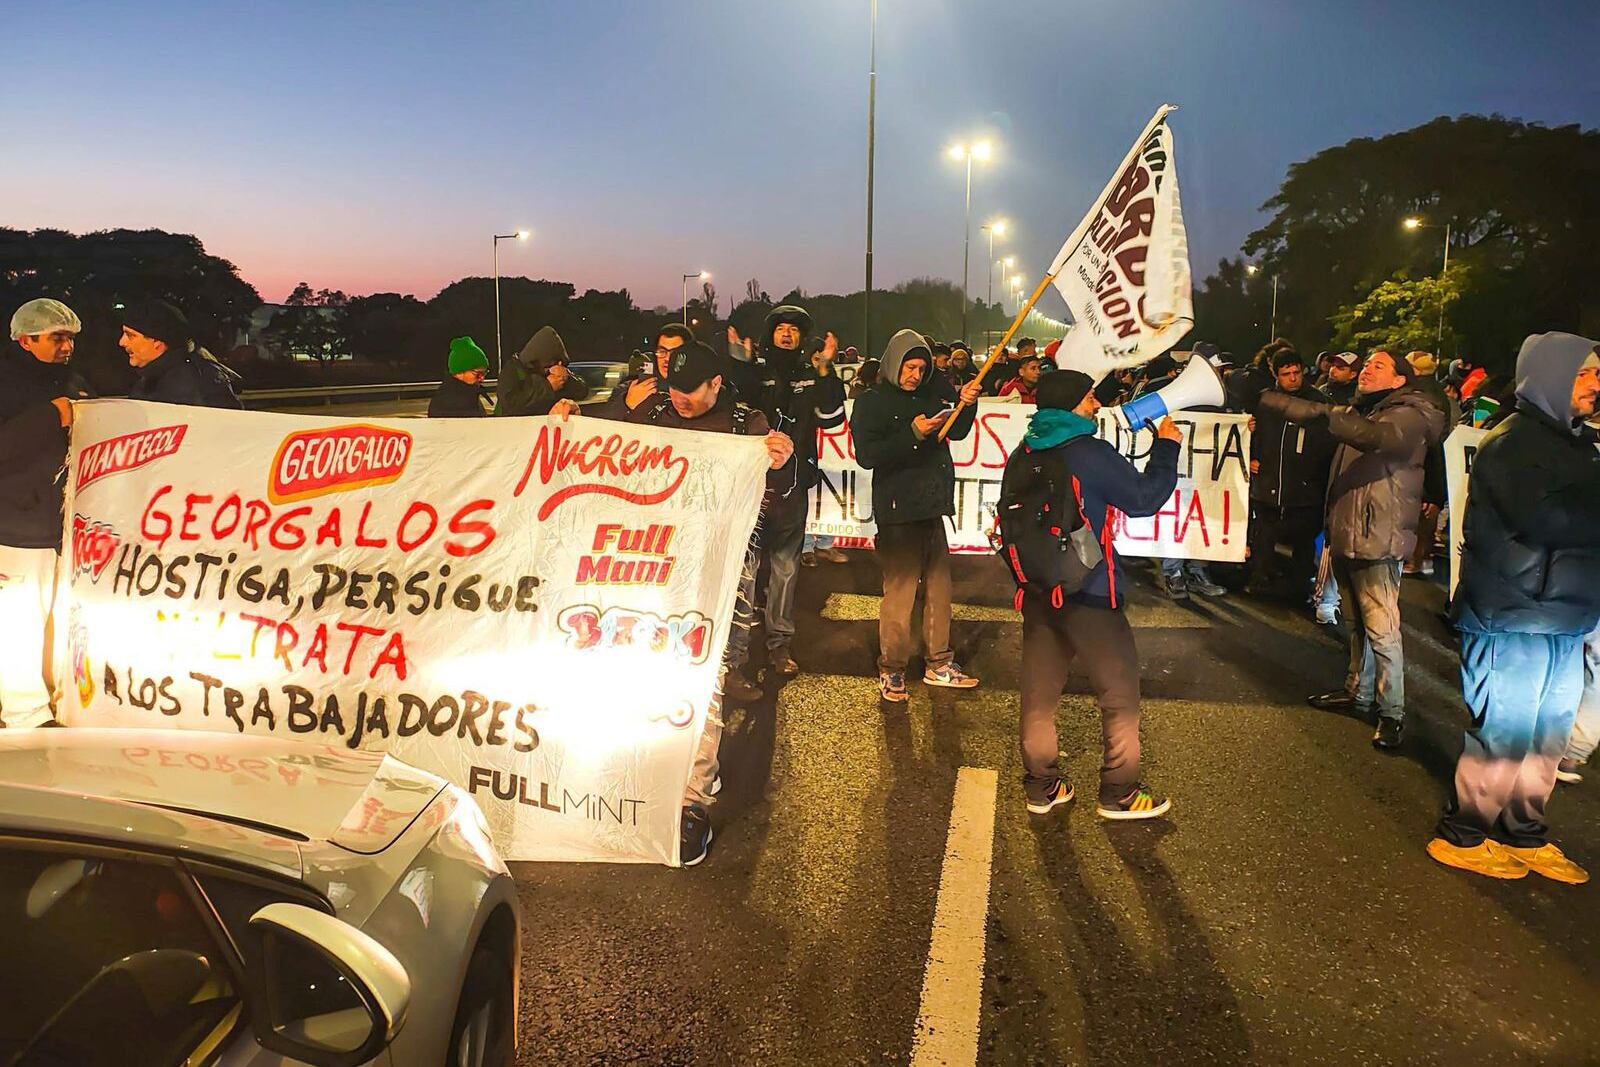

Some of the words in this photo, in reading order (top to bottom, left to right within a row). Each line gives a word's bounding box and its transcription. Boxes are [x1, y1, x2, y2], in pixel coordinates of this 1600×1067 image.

[79, 425, 179, 482] MANTECOL
[279, 435, 408, 486] GEORGALOS
[140, 485, 498, 557] GEORGALOS
[591, 523, 676, 556] Full
[126, 666, 182, 716] LOS
[189, 671, 541, 752] TRABAJADORES
